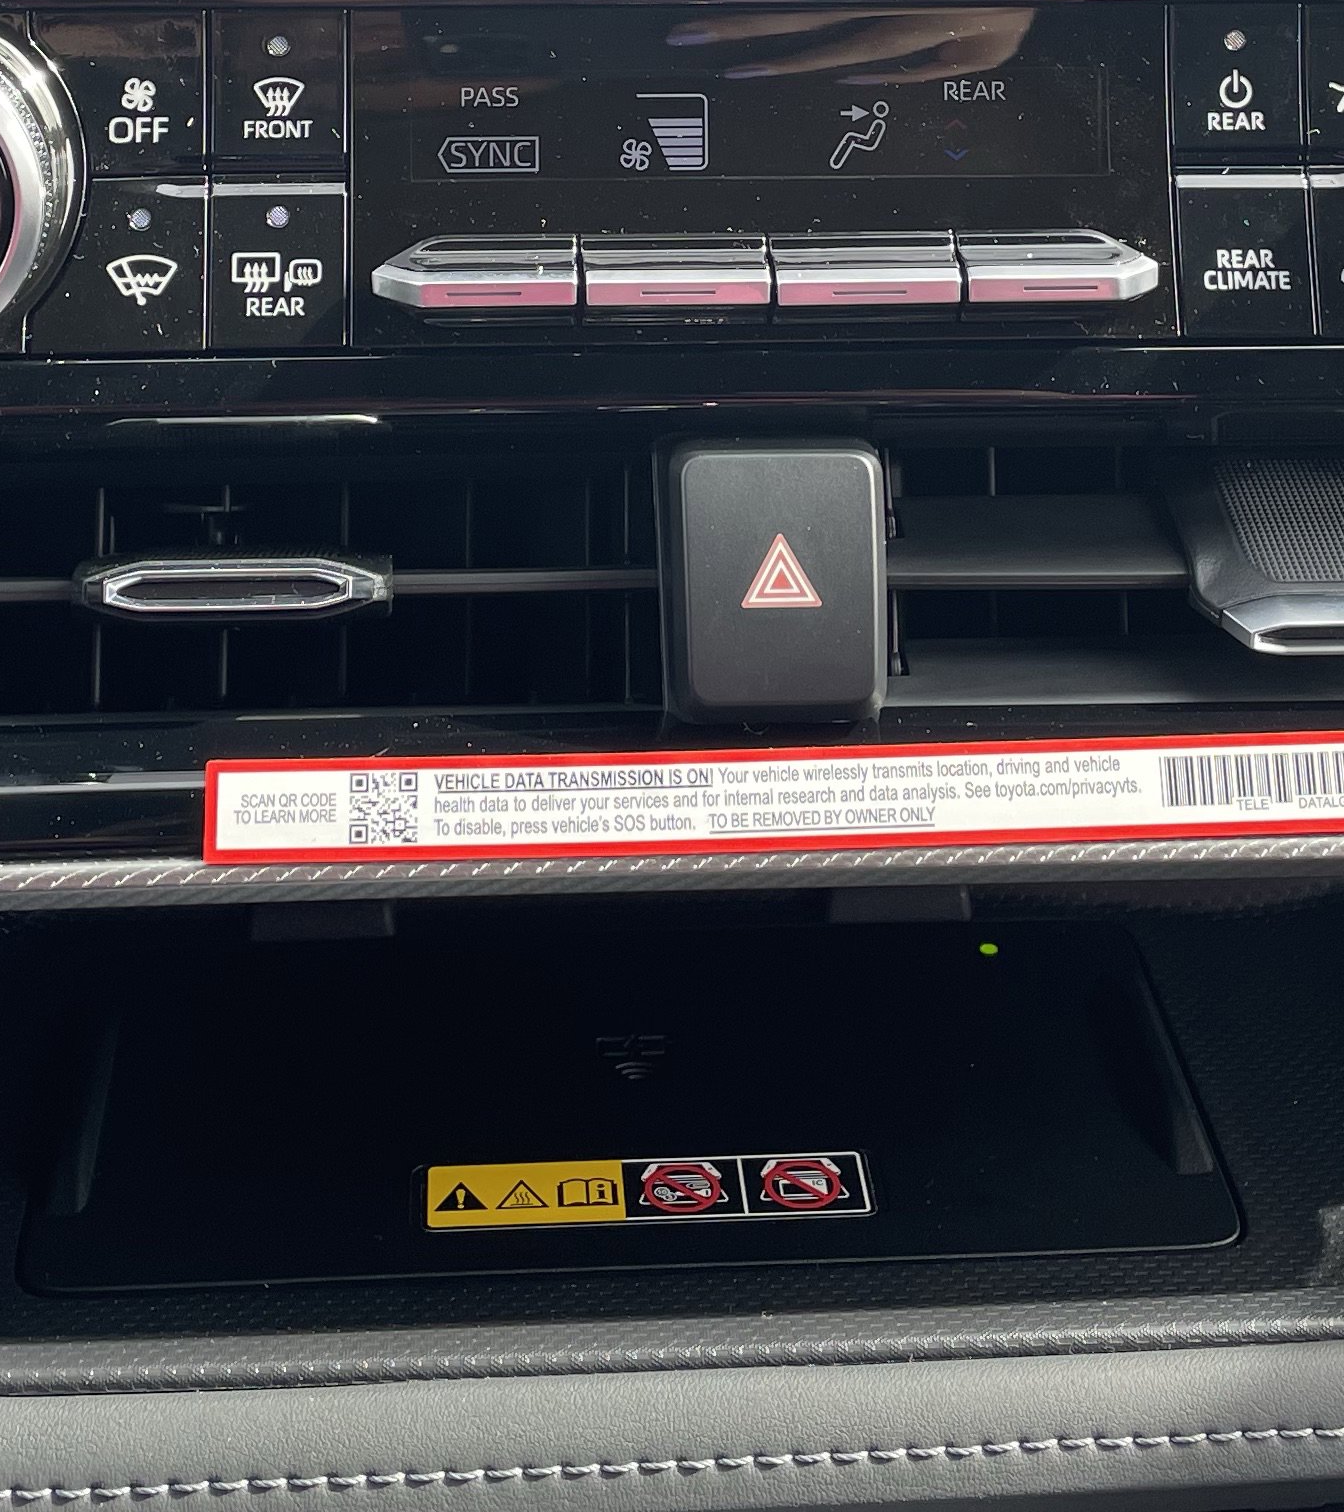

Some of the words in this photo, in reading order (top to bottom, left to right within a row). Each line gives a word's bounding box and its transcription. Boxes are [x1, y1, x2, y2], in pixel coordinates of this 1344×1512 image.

[460, 87, 518, 108] PASS
[943, 80, 1006, 102] REAR
[108, 118, 169, 145] OFF
[243, 120, 313, 140] FRONT
[1207, 112, 1265, 131] REAR
[449, 141, 533, 168] SYNC
[1217, 249, 1274, 269] REAR
[1203, 270, 1291, 291] CLIMATE
[245, 297, 305, 317] REAR
[434, 773, 501, 790] VEHICLE
[505, 772, 544, 789] DATA
[548, 769, 664, 788] TRANSMISSION
[669, 768, 683, 785] IS
[687, 767, 714, 785] ON!
[718, 767, 749, 784] Your
[753, 766, 800, 783] vehicle
[803, 763, 869, 784] wirelessly
[872, 760, 933, 778] transmits
[937, 759, 993, 777] location,
[997, 758, 1041, 777] driving
[1045, 757, 1070, 773] and
[1074, 755, 1120, 772] vehicle
[241, 793, 276, 808] SCAN
[279, 793, 298, 808] QR
[301, 792, 337, 807] CODE
[434, 796, 475, 813] health
[479, 796, 508, 812] data
[514, 796, 527, 812] to
[531, 794, 575, 811] deliver
[580, 796, 610, 814] your
[614, 792, 669, 809] services
[673, 790, 698, 808] and
[702, 790, 720, 807] for
[724, 788, 773, 806] internal
[778, 786, 836, 805] research
[840, 784, 865, 802] and
[869, 784, 898, 801] data
[902, 781, 960, 802] analysis.
[965, 781, 991, 799] See
[1236, 798, 1269, 811] TELE
[234, 810, 251, 825] TO
[255, 809, 296, 824] LEARN
[299, 809, 337, 823] MORE
[434, 818, 451, 836] To
[454, 816, 506, 838] disable,
[511, 820, 548, 839] press
[552, 815, 610, 834] vehicle's
[614, 814, 645, 832] SOS
[650, 812, 696, 831] button.
[709, 813, 727, 829] TO
[731, 812, 749, 828] BE
[752, 810, 821, 827] REMOVED
[824, 809, 842, 825] BY
[845, 807, 897, 824] OWNER
[900, 806, 936, 823] ONLY
